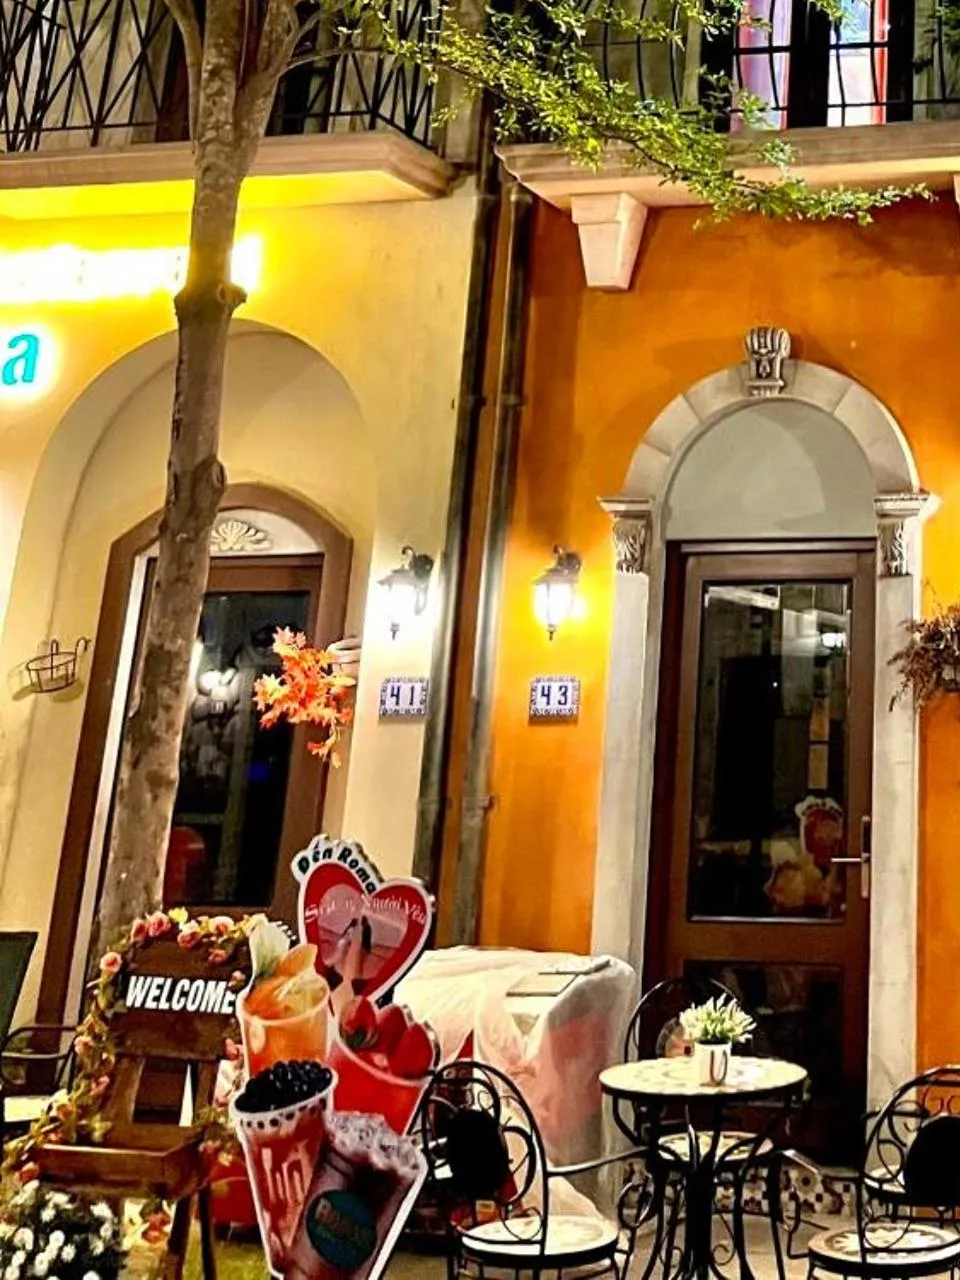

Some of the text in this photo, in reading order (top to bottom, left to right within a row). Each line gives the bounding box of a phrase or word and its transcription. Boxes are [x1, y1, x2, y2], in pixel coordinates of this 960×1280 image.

[390, 685, 415, 706] 41
[540, 685, 569, 706] 43
[337, 846, 377, 897] Roma
[126, 974, 236, 1015] WELCOME
